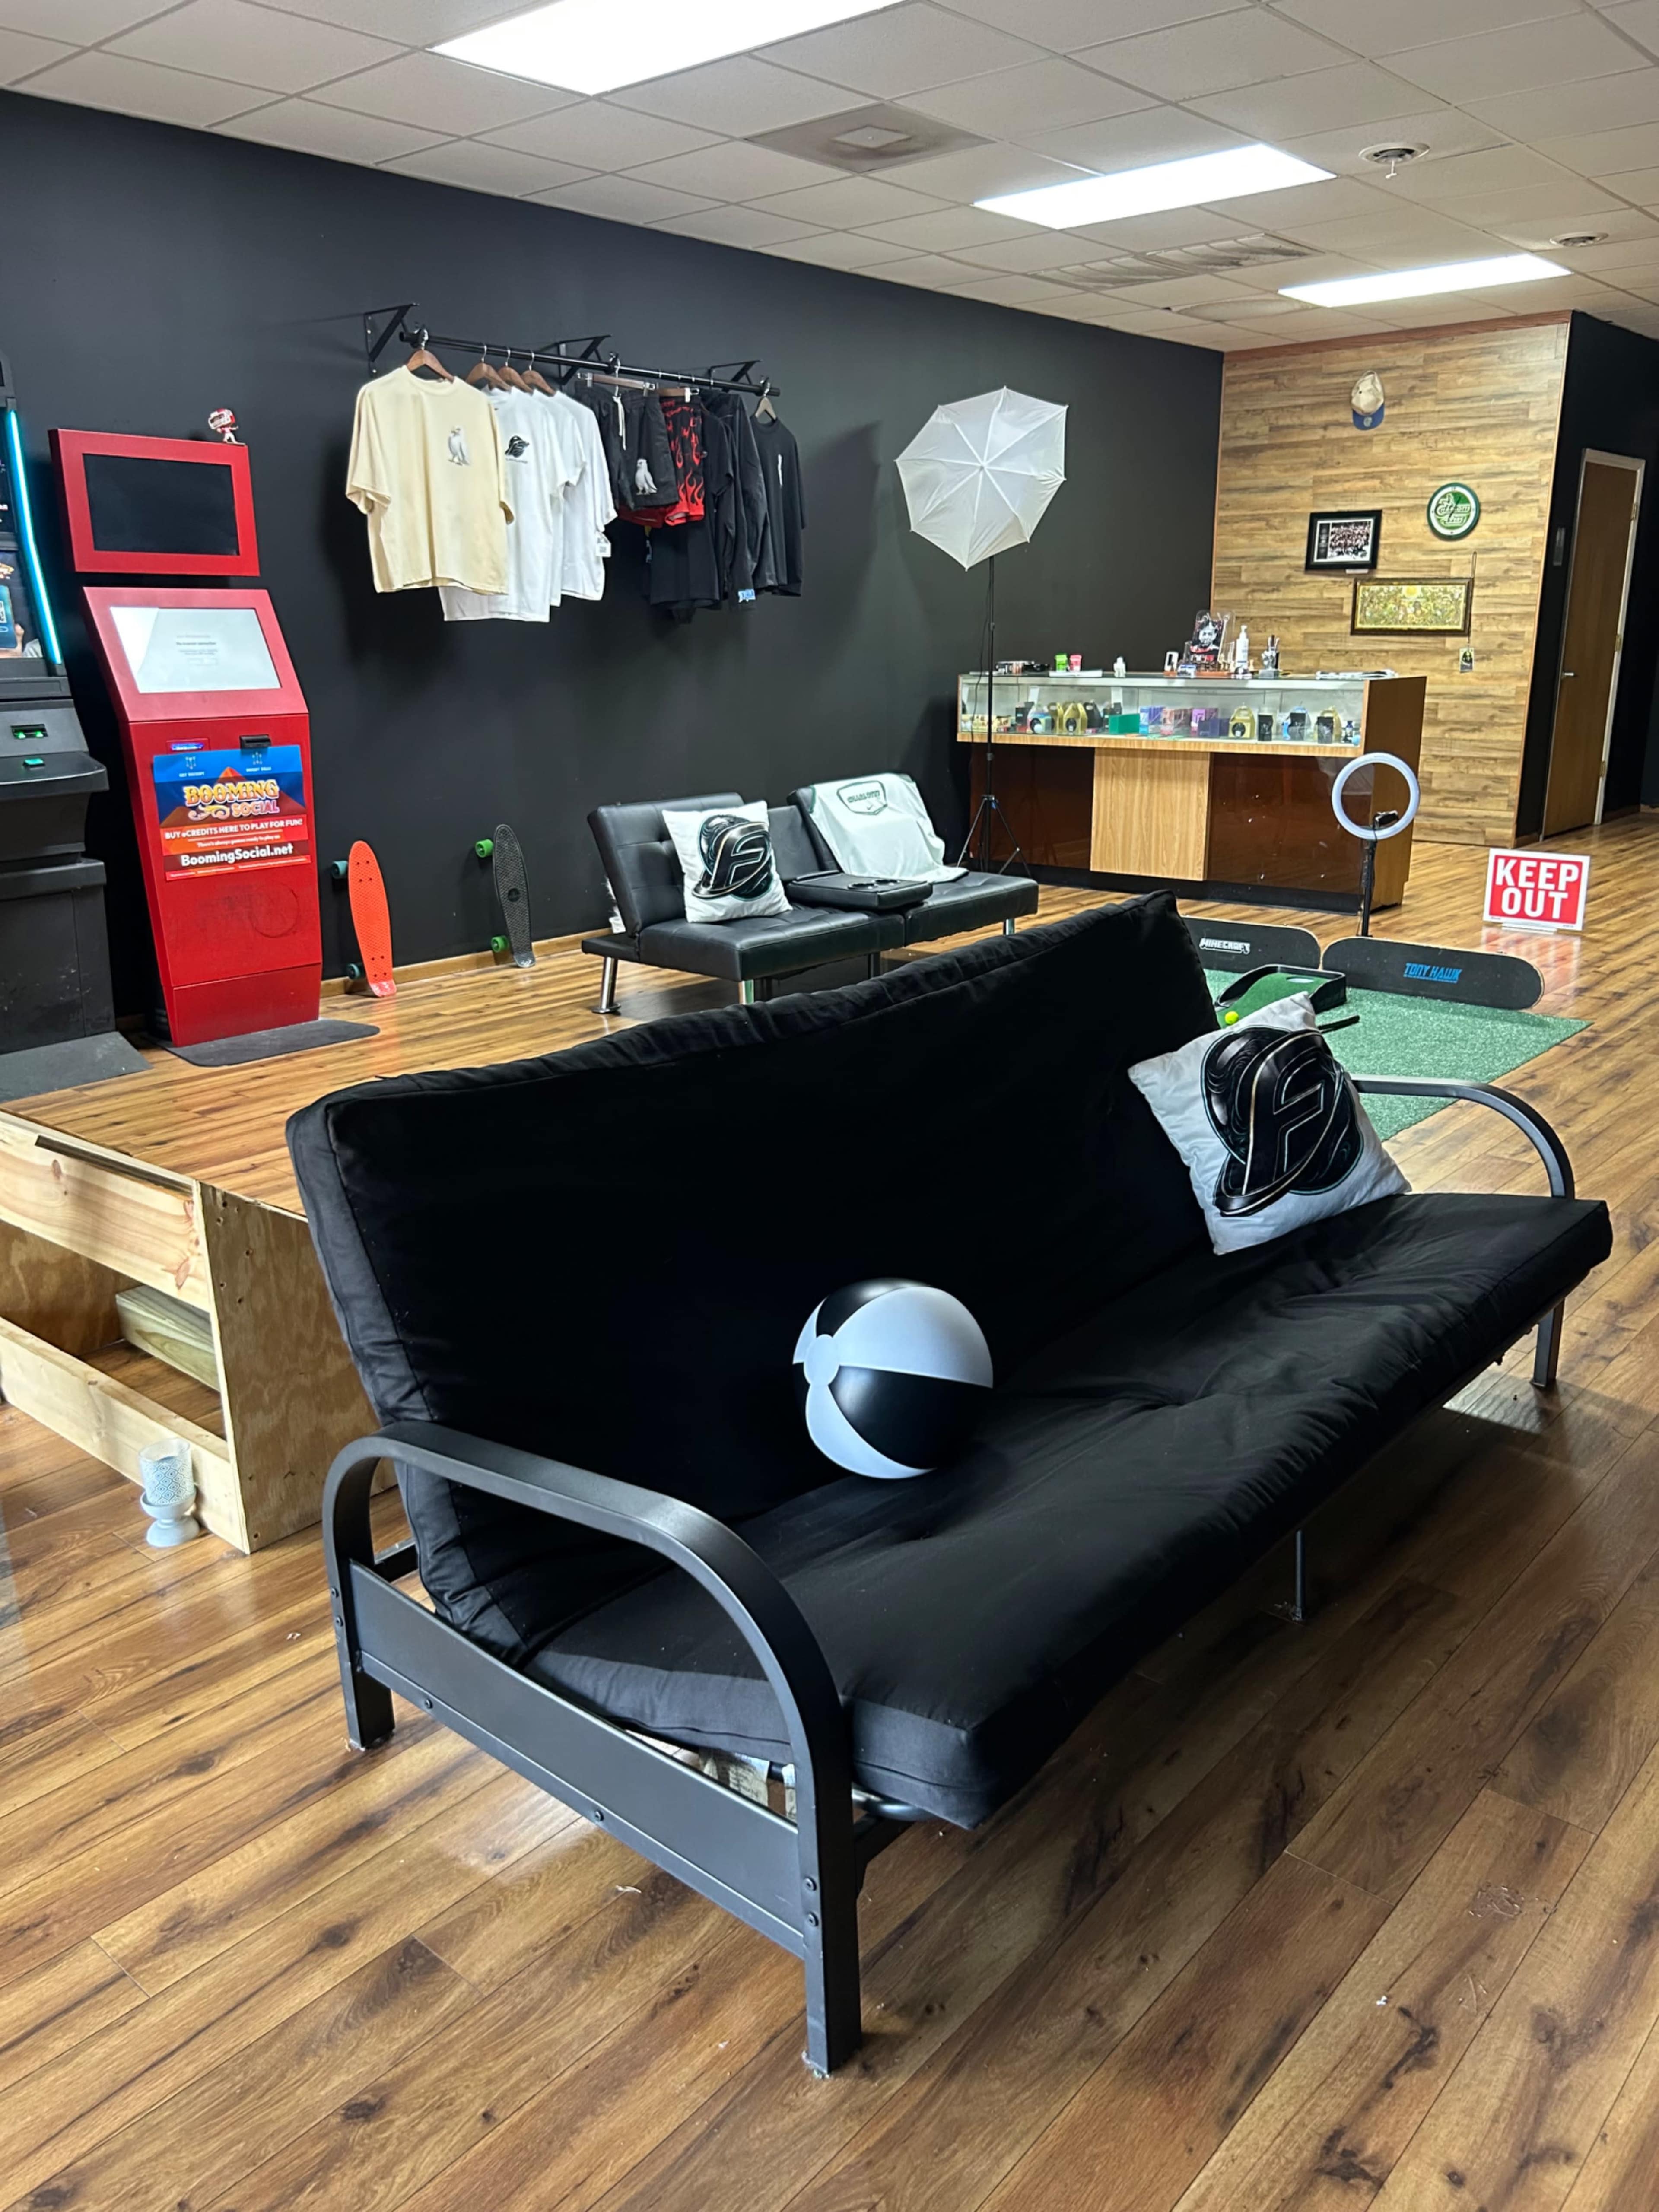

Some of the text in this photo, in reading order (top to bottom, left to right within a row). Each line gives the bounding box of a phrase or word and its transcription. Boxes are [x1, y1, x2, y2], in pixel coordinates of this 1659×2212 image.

[183, 779, 279, 807] BOOMING
[231, 800, 280, 817] SOCIAL
[165, 830, 181, 839] BUY
[181, 826, 218, 838] eCREDITS
[219, 824, 238, 833] HERE
[251, 822, 269, 830] PLAY
[180, 843, 294, 867] BoomingSocial.net
[1495, 858, 1579, 891] KEEP
[1501, 887, 1568, 919] OUT
[1199, 938, 1250, 954] MINECRAFT
[1405, 963, 1463, 980] TONY HAWK
